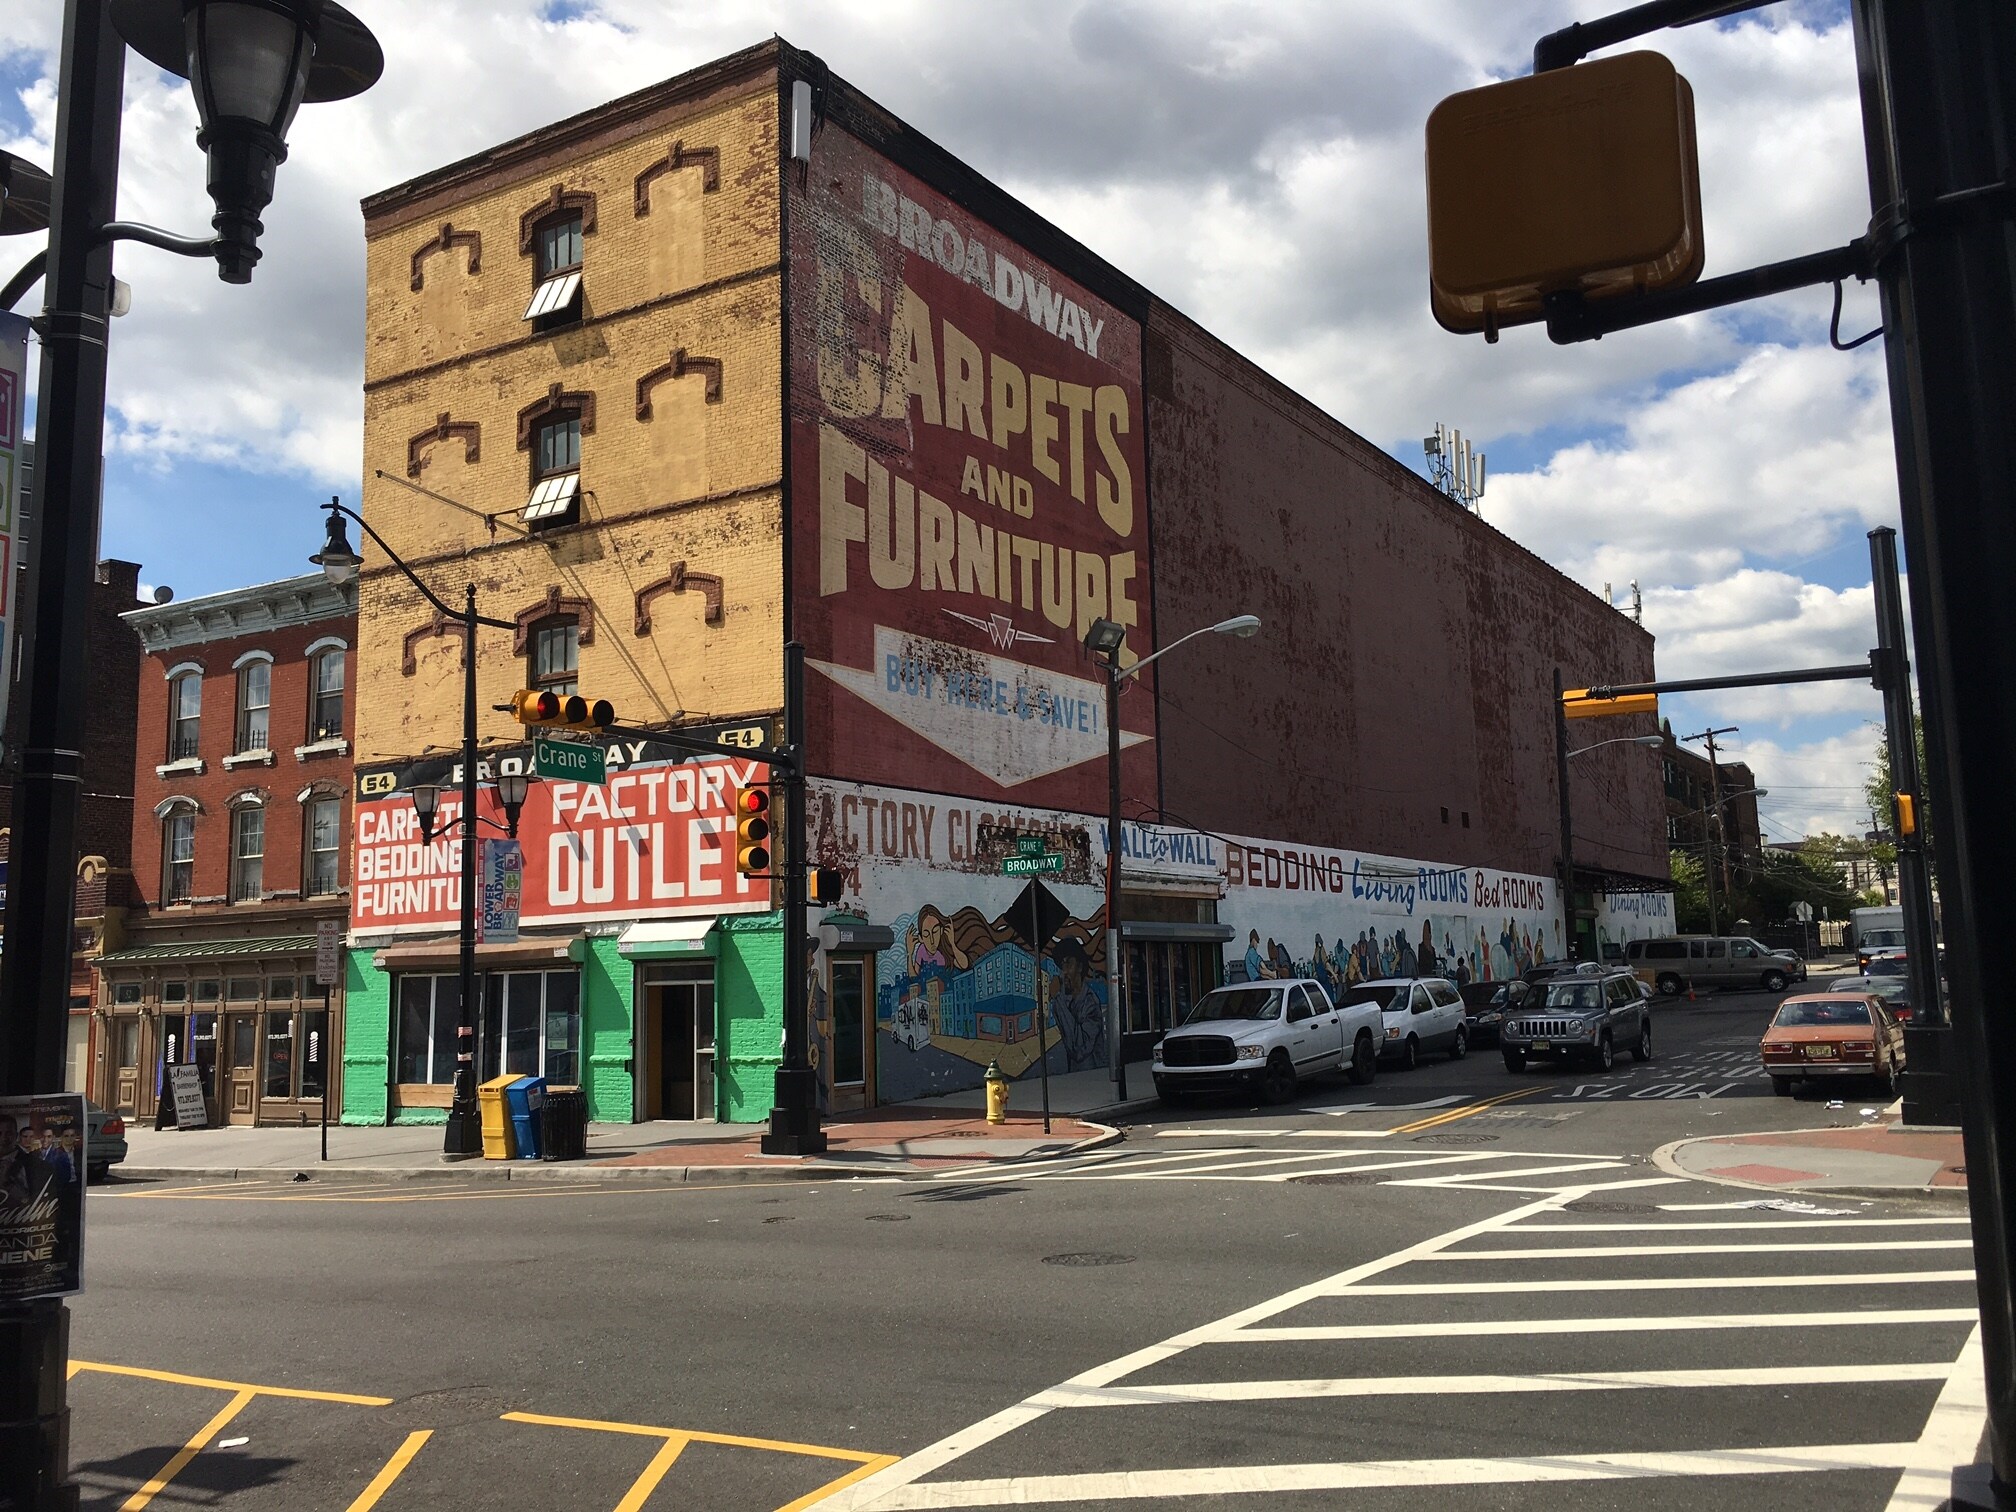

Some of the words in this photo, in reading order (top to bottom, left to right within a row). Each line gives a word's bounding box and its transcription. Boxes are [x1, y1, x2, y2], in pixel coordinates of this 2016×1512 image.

[863, 173, 1104, 359] BROADWAY
[817, 207, 1133, 537] CARPETS
[960, 455, 1034, 520] AND
[819, 416, 1140, 680] FURNITURE
[886, 653, 936, 699] BUY
[948, 667, 1008, 716] HERE
[1040, 691, 1098, 735] SAVE!
[452, 741, 648, 783] BROAY
[538, 743, 587, 770] Crane
[592, 752, 602, 763] St
[366, 777, 390, 792] 54
[552, 761, 760, 825] FACTORY
[358, 839, 463, 881] BEDDING
[1007, 857, 1057, 872] BROADWAY
[1019, 841, 1037, 852] CRANE
[1150, 829, 1169, 858] to
[1169, 834, 1216, 866] WALL
[1225, 843, 1343, 894] BEDDING
[1351, 857, 1416, 914] Living
[1418, 866, 1468, 904] ROOMS
[484, 883, 494, 930] LOWER
[1474, 869, 1500, 908] Bed
[1502, 876, 1544, 911] ROOMS
[1640, 893, 1667, 918] ROOMS
[1551, 1082, 1745, 1099] SLOW
